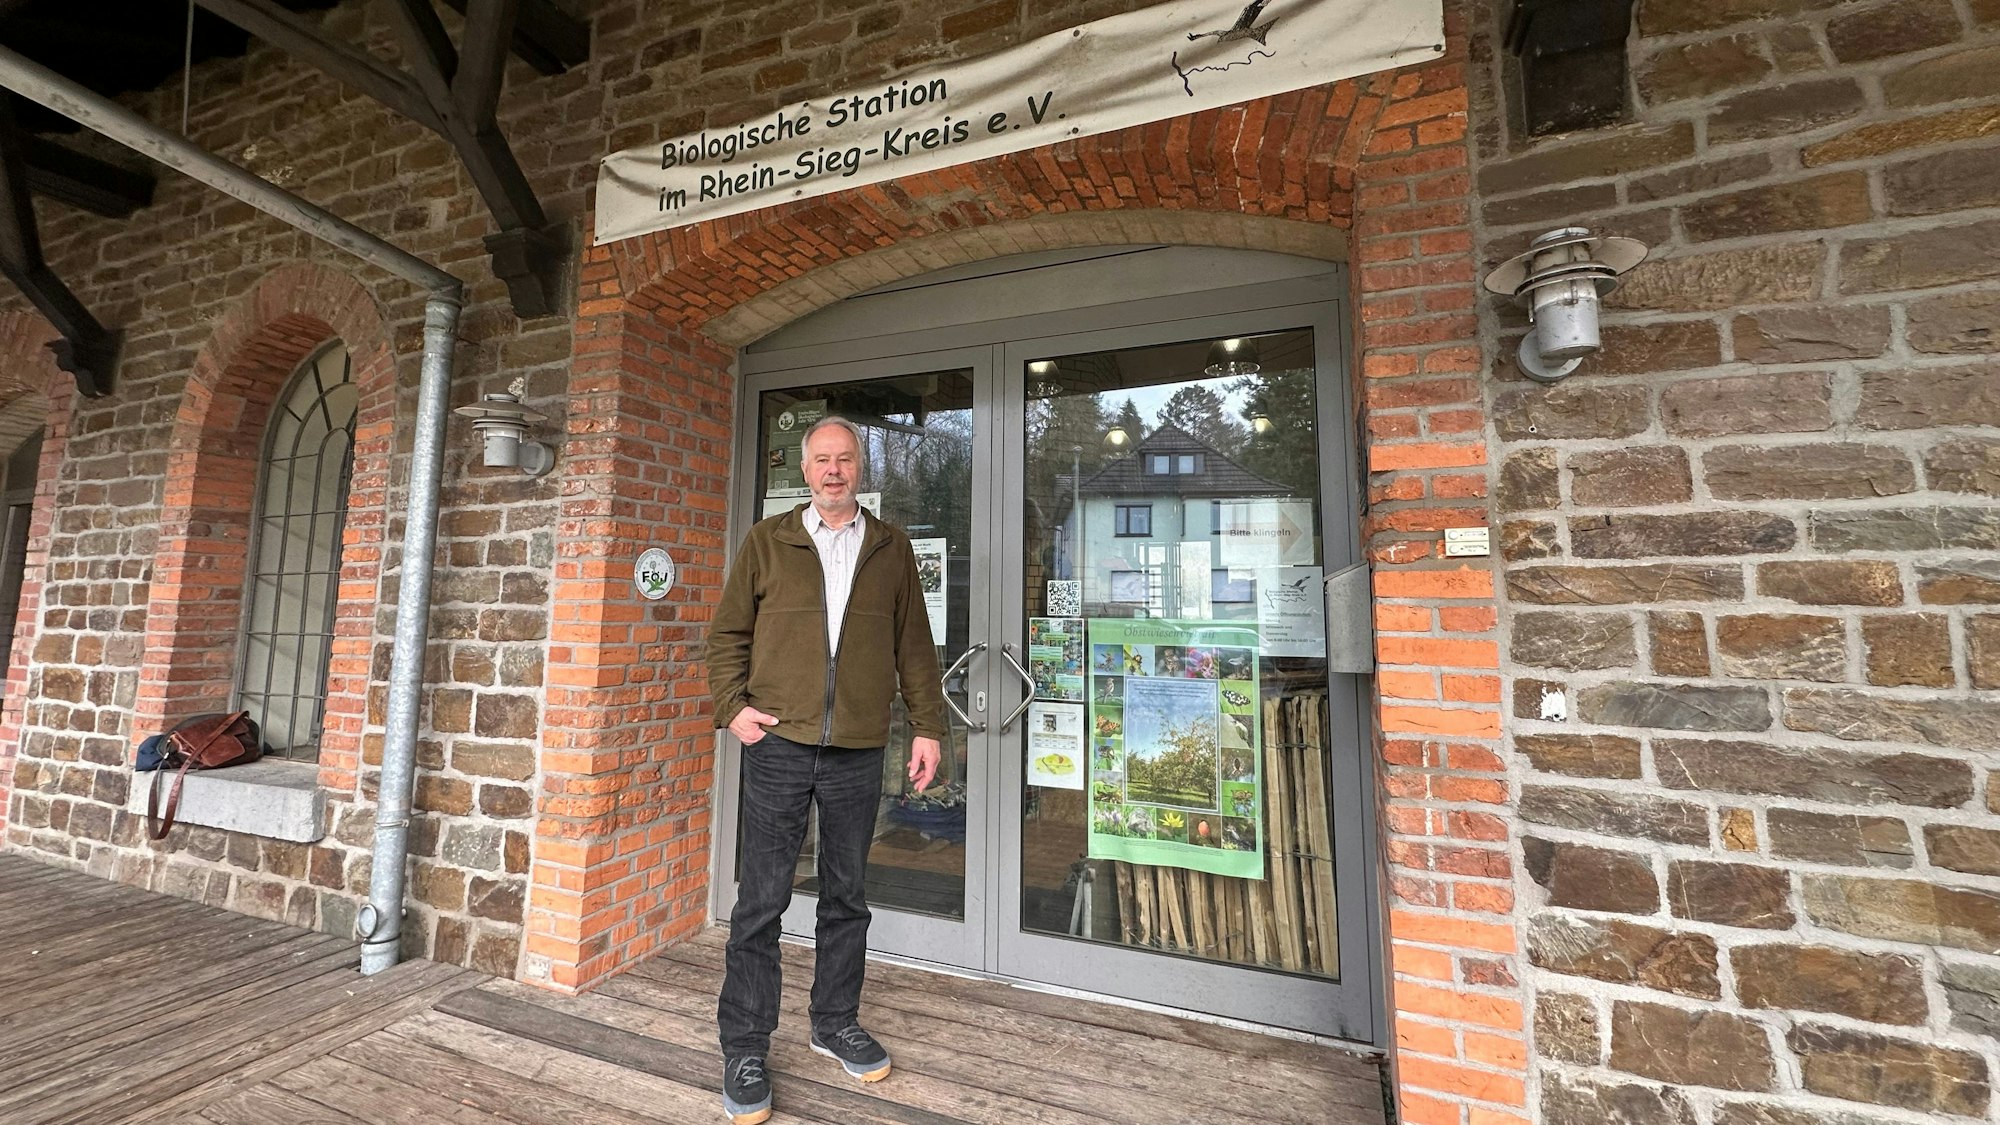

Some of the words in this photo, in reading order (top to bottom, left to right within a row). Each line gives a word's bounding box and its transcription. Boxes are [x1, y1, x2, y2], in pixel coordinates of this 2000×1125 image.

[661, 112, 811, 170] Biologische
[826, 78, 947, 128] Station
[659, 187, 687, 211] im
[699, 116, 969, 202] Rhein-Sieg-Kreis
[1229, 529, 1251, 537] Bitte
[1253, 528, 1291, 538] klingeln
[642, 570, 668, 583] FÖJ
